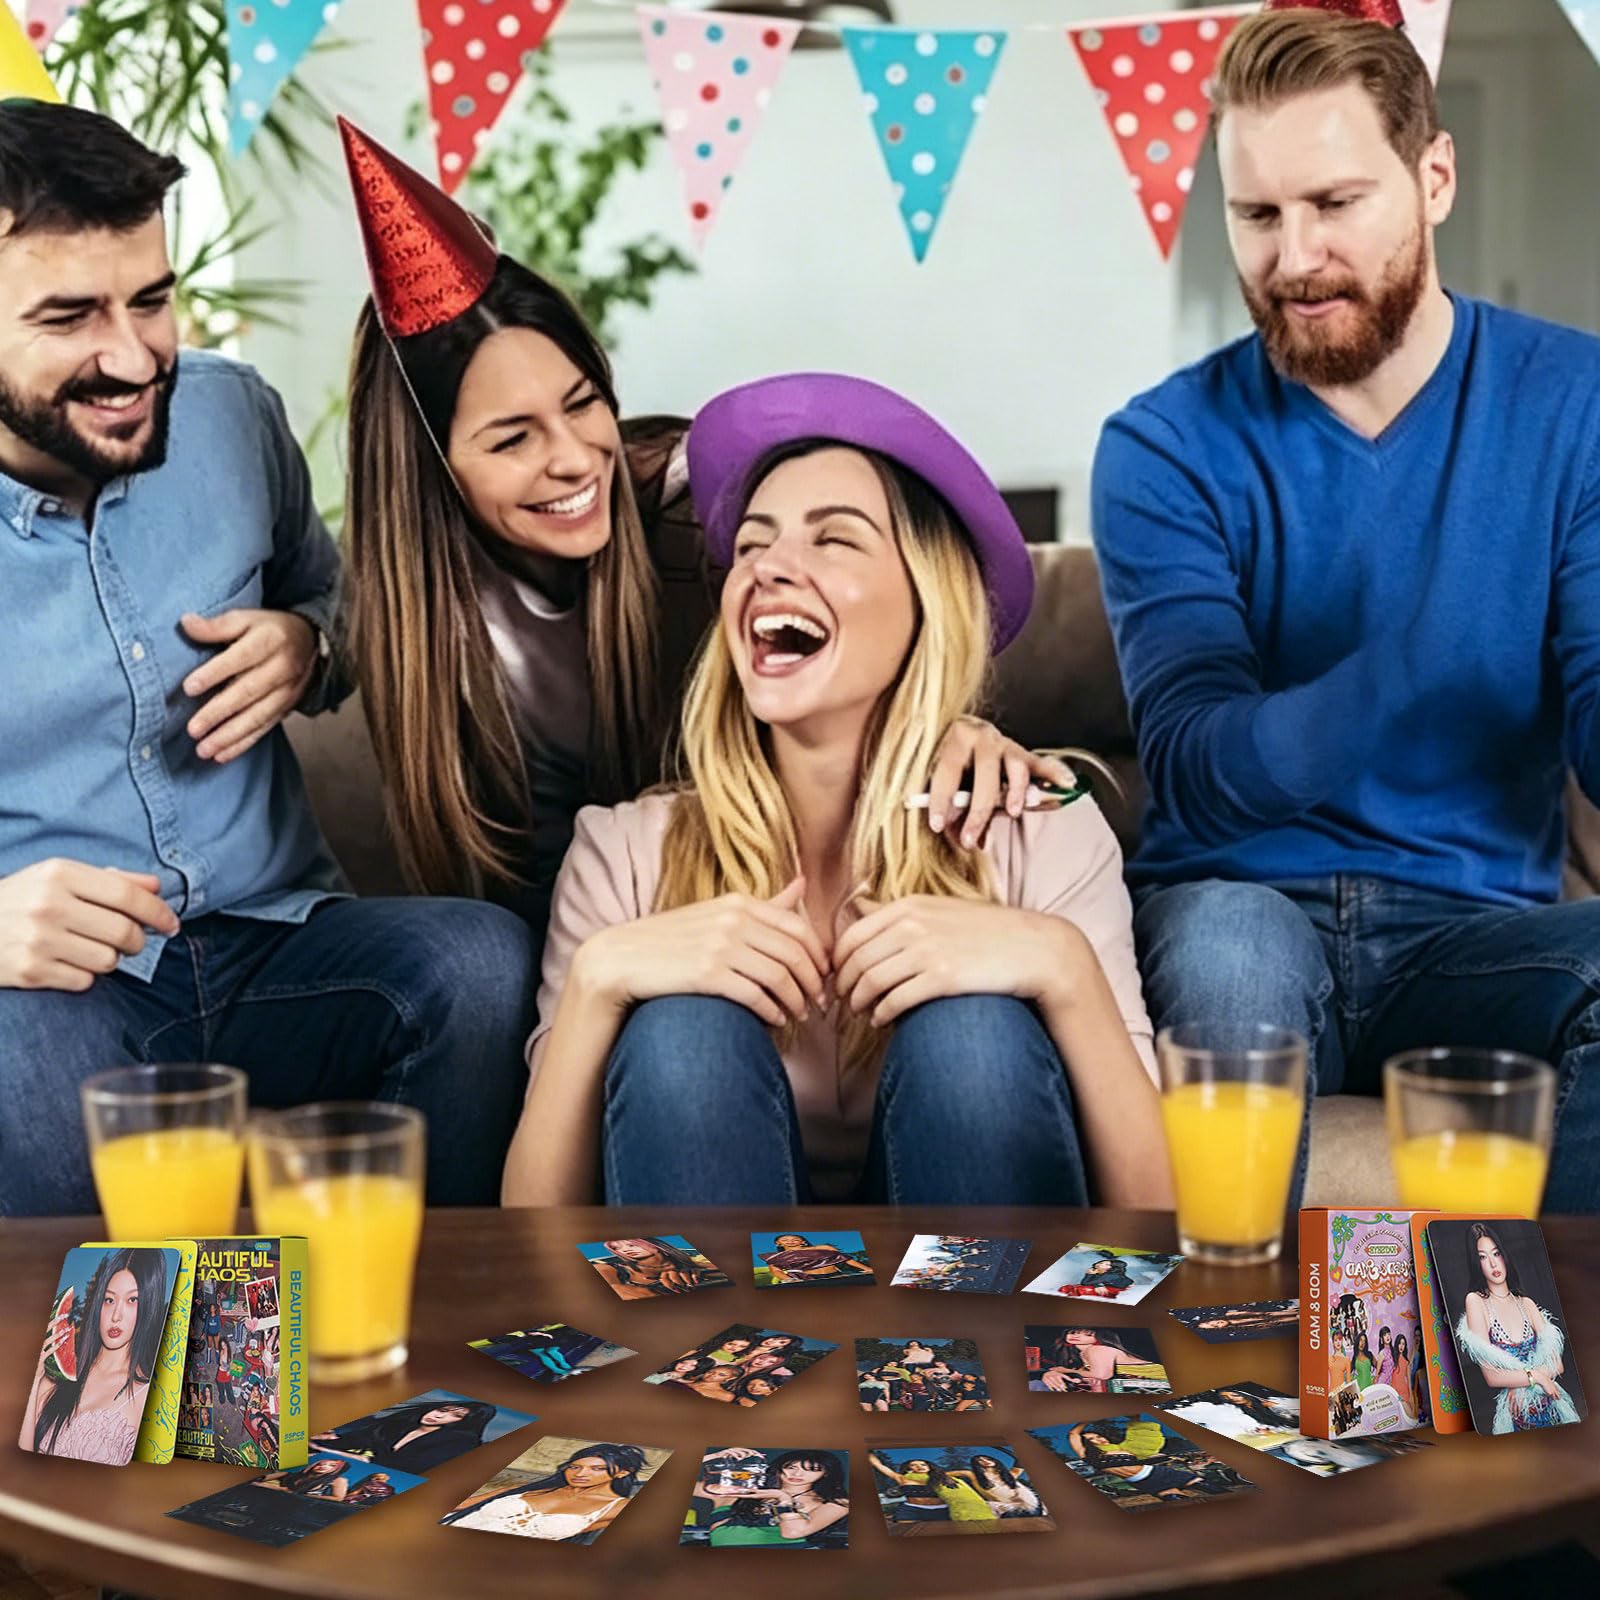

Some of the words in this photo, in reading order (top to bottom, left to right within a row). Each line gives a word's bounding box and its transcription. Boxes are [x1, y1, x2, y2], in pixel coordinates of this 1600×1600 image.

[198, 1251, 274, 1268] AUTIFUL
[196, 1268, 251, 1282] HAOS
[290, 1270, 302, 1359] BEAUTIFUL
[289, 1360, 301, 1417] CHAOS
[177, 1429, 215, 1446] EAUTIFUL
